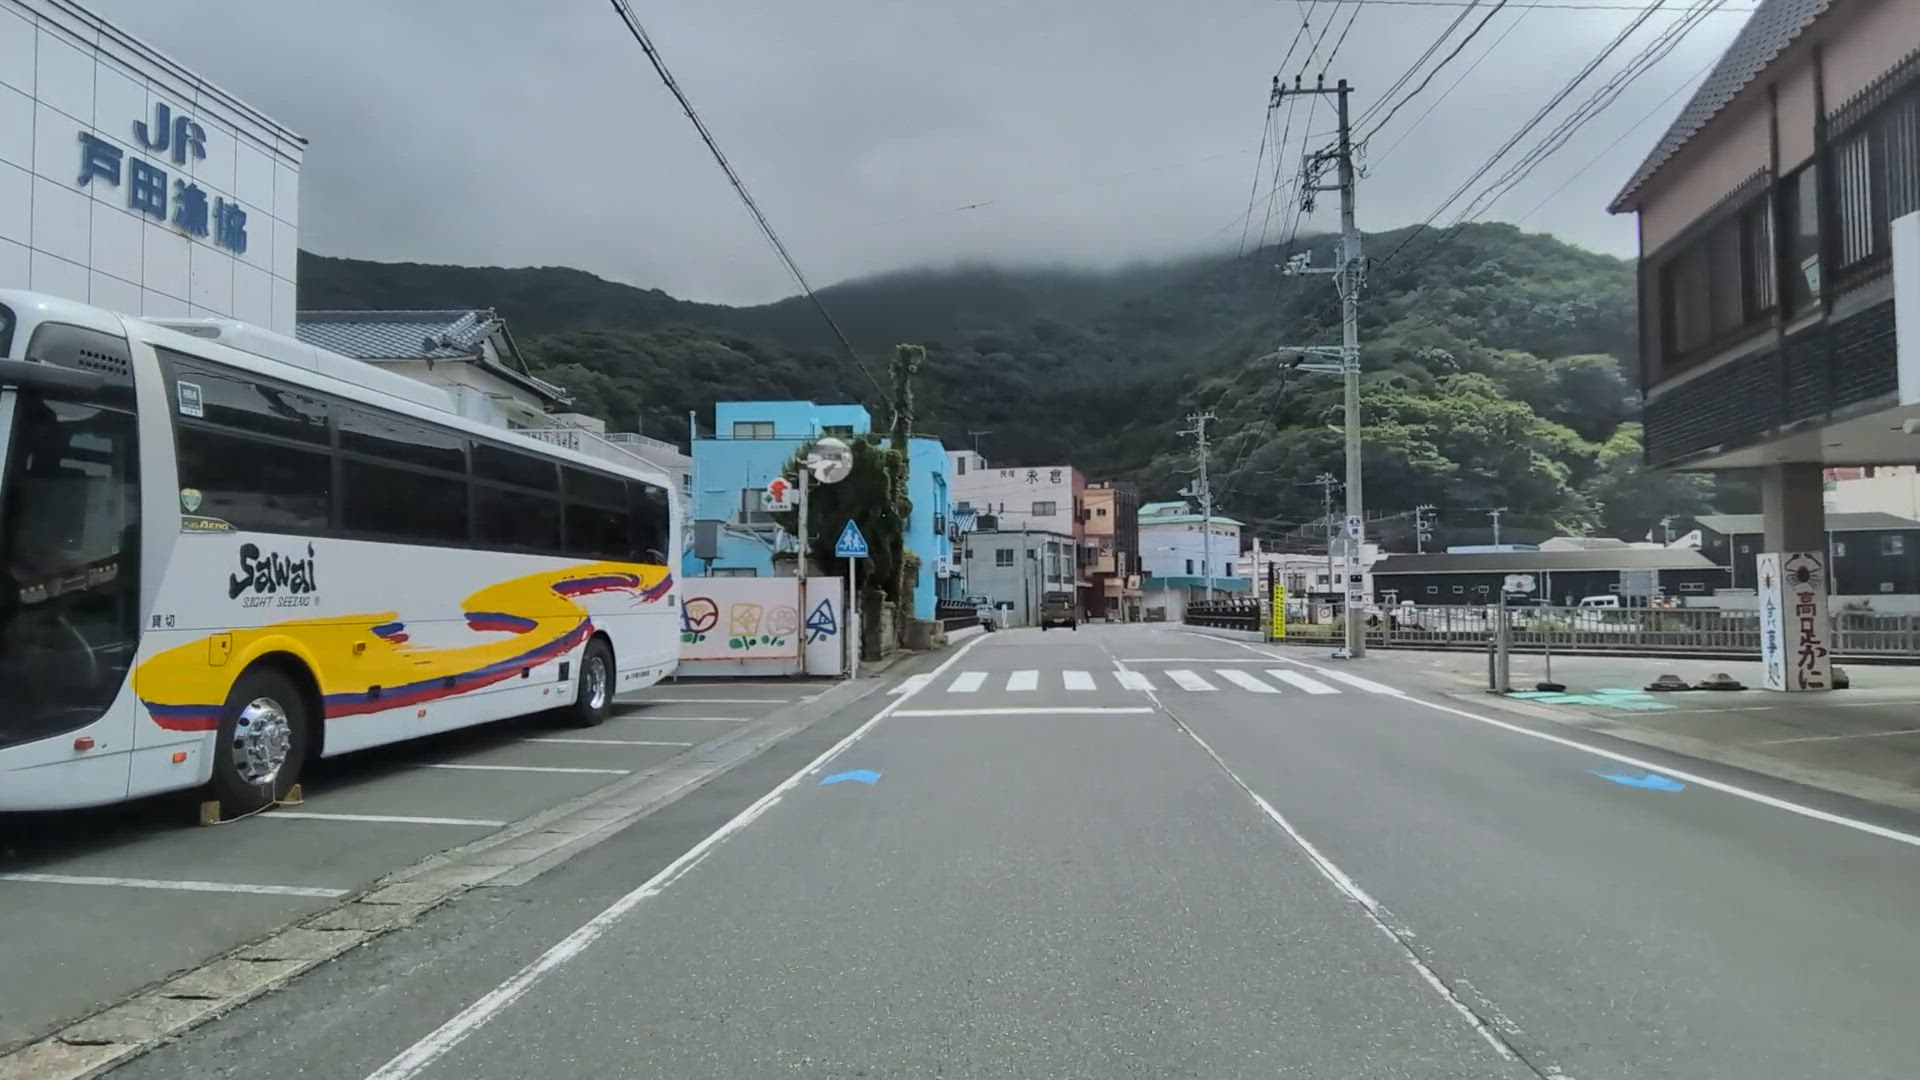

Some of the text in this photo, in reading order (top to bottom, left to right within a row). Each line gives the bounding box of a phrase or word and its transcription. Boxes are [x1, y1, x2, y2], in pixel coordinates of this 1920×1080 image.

[78, 130, 247, 255] 戸田漁協
[228, 541, 317, 600] Sawai
[242, 596, 311, 608] SIGHT SEEING
[1796, 591, 1827, 690] 高足かに
